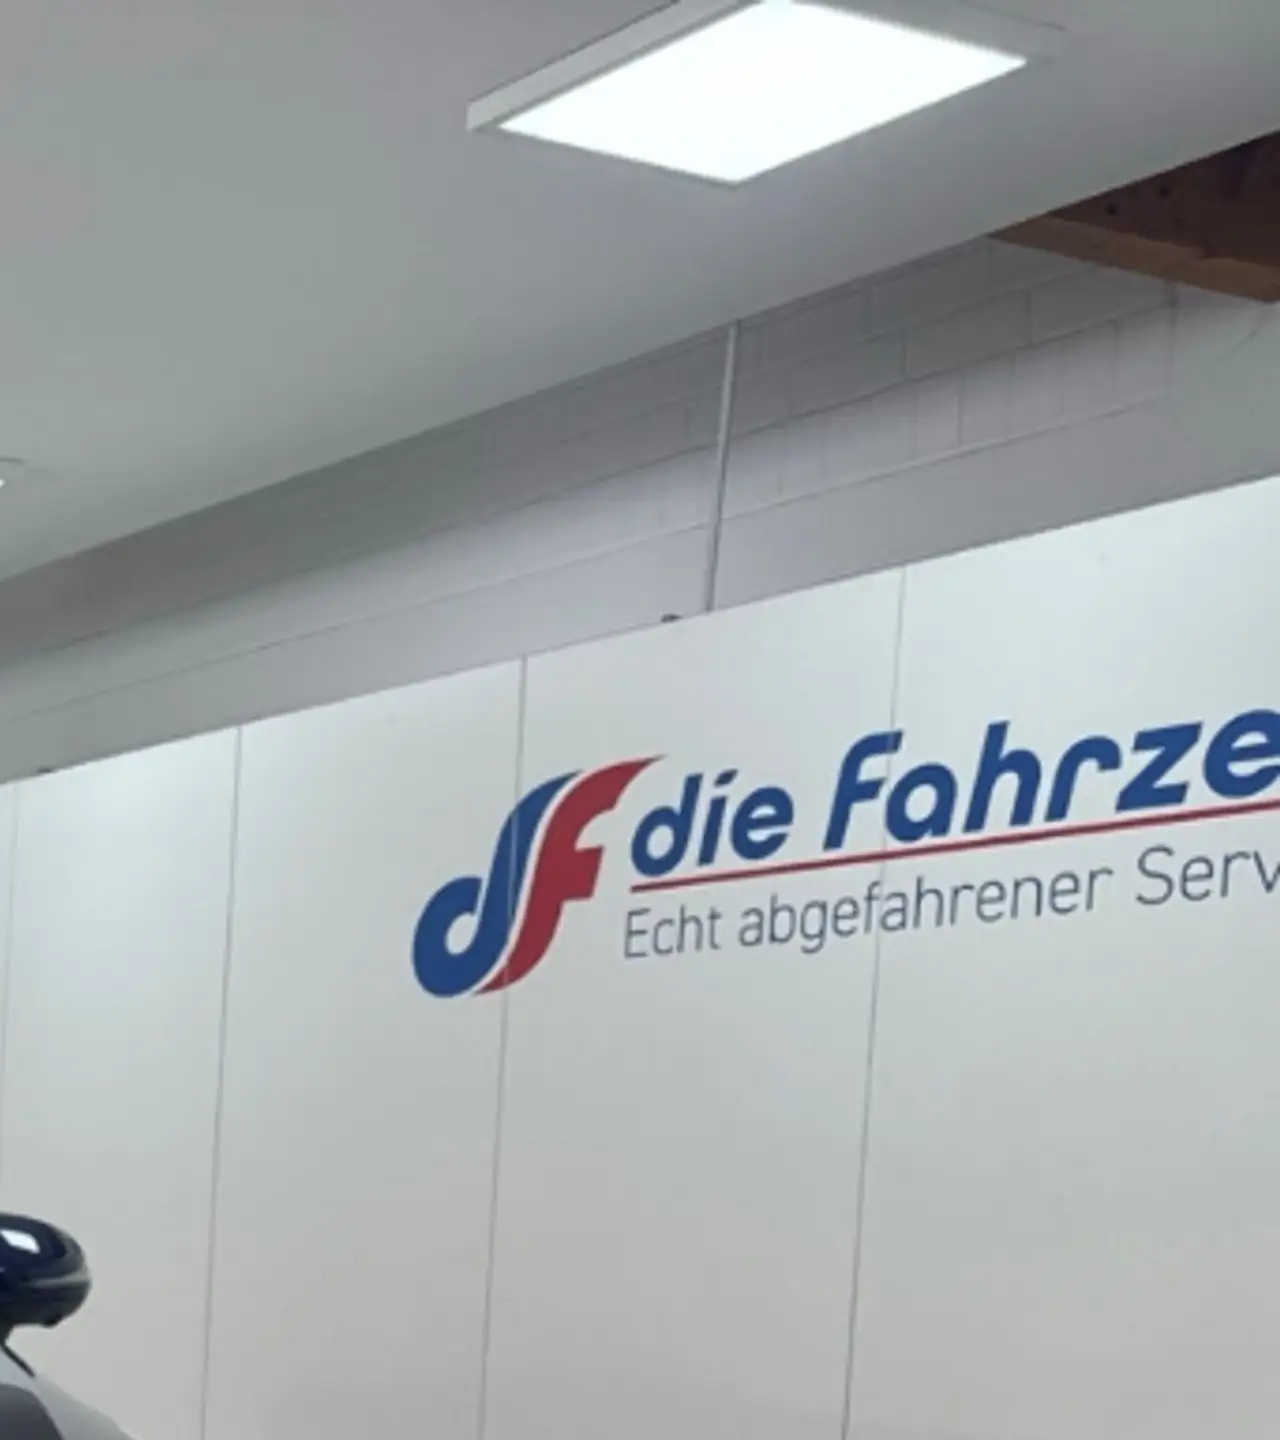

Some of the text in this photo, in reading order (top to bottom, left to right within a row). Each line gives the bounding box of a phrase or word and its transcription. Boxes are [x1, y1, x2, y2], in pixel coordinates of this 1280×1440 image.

[631, 709, 1280, 877] die Fahrze
[624, 844, 1280, 959] Echt abgefahrener Serv
